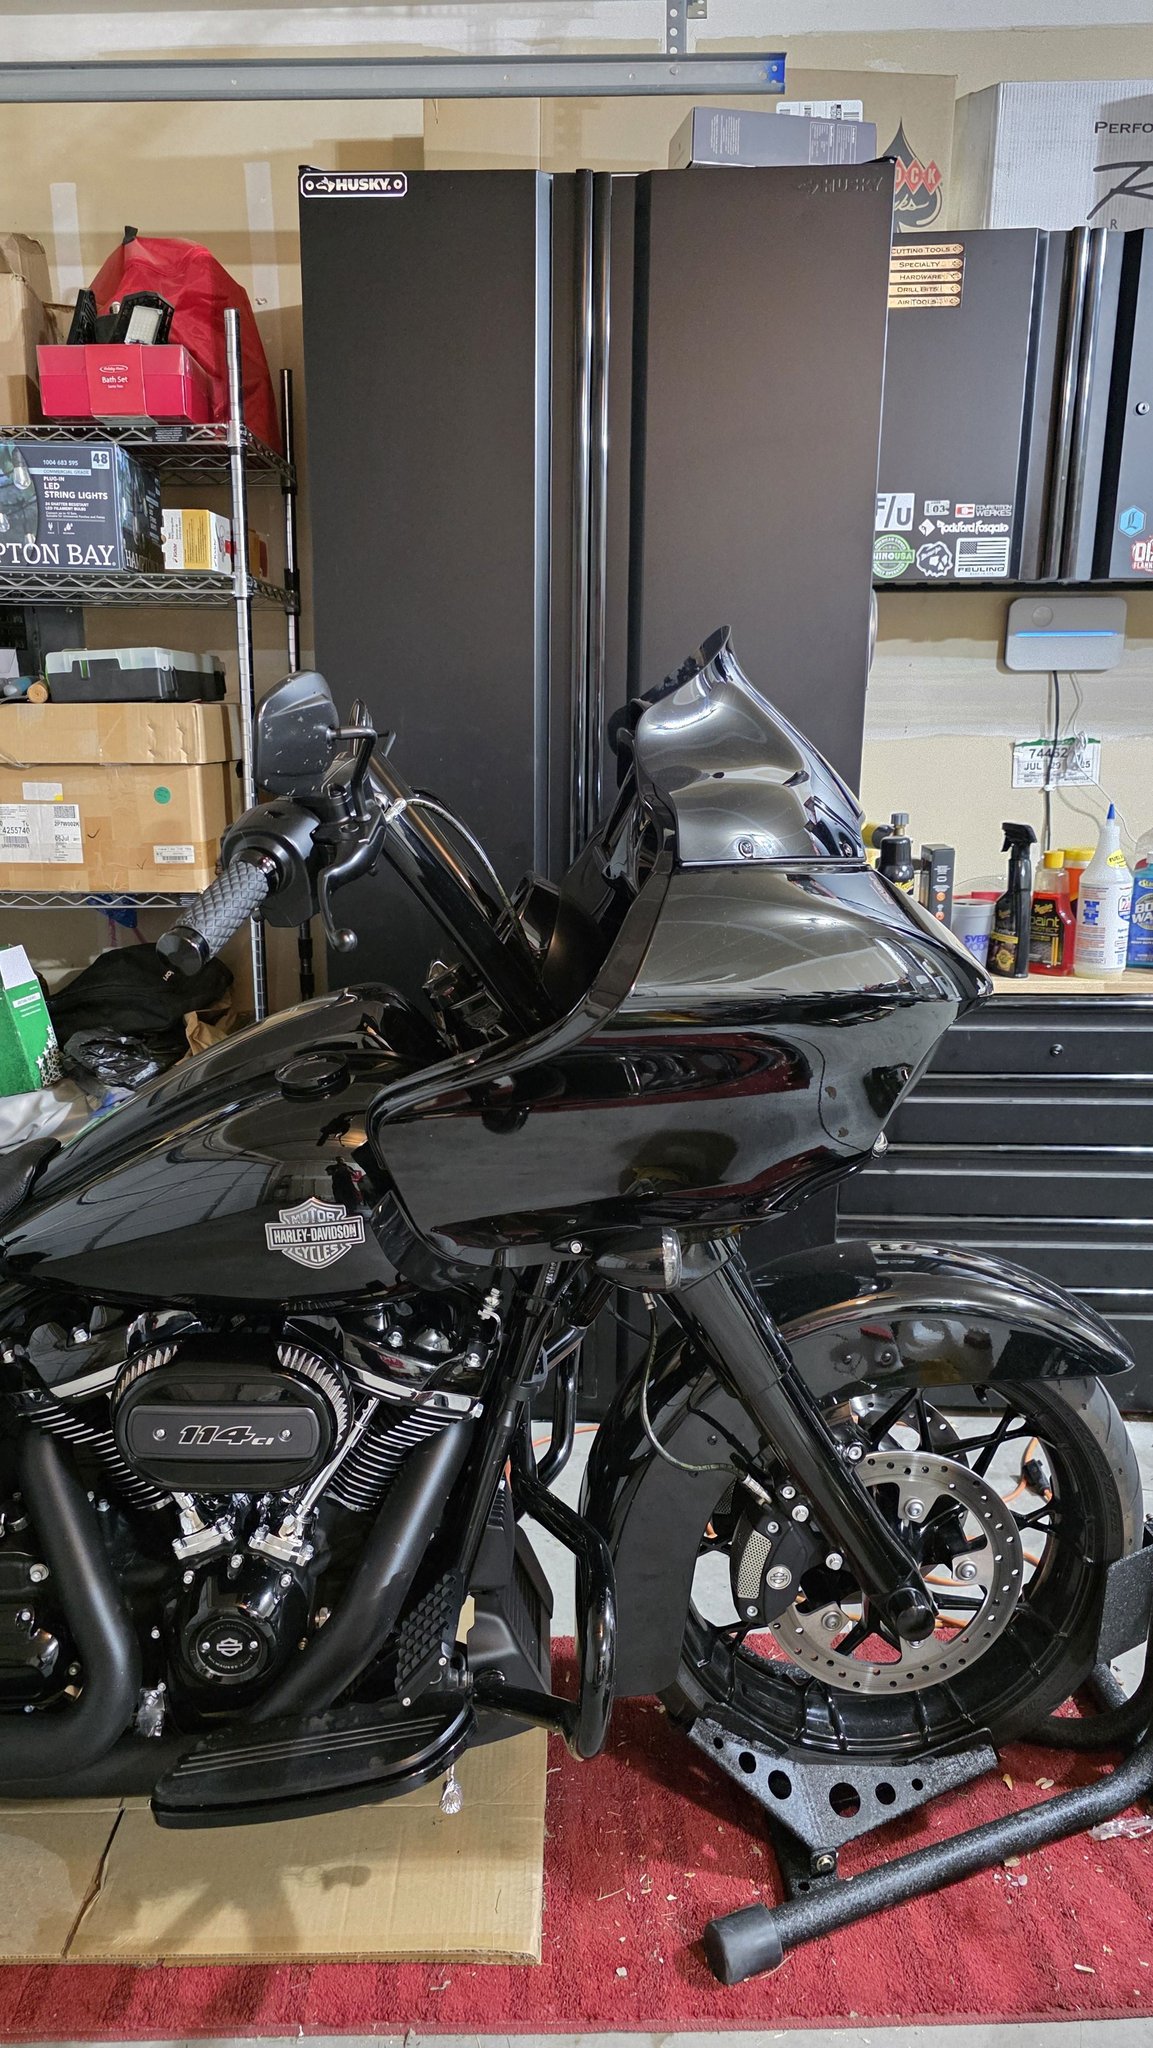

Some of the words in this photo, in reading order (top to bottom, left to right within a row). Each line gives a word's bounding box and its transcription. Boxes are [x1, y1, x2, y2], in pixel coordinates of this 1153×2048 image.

[1095, 121, 1153, 134] PERFO
[335, 178, 391, 191] HUSKY
[824, 177, 883, 193] HUSKY
[890, 247, 923, 255] CUTTING
[925, 246, 951, 254] TOOLS
[101, 376, 117, 384] Bath
[93, 453, 108, 464] 48
[43, 482, 60, 490] LED
[44, 491, 76, 499] STRING
[78, 491, 108, 500] LIGHTS
[932, 505, 946, 513] 03
[67, 544, 115, 566] BAY
[1024, 762, 1042, 770] JUL
[1030, 916, 1060, 928] paint
[290, 1207, 336, 1224] MOTOR
[273, 1223, 357, 1244] HARLEY-DAVIDSON
[294, 1244, 339, 1262] CYCLES
[178, 1425, 256, 1445] 114
[251, 1437, 275, 1446] CI
